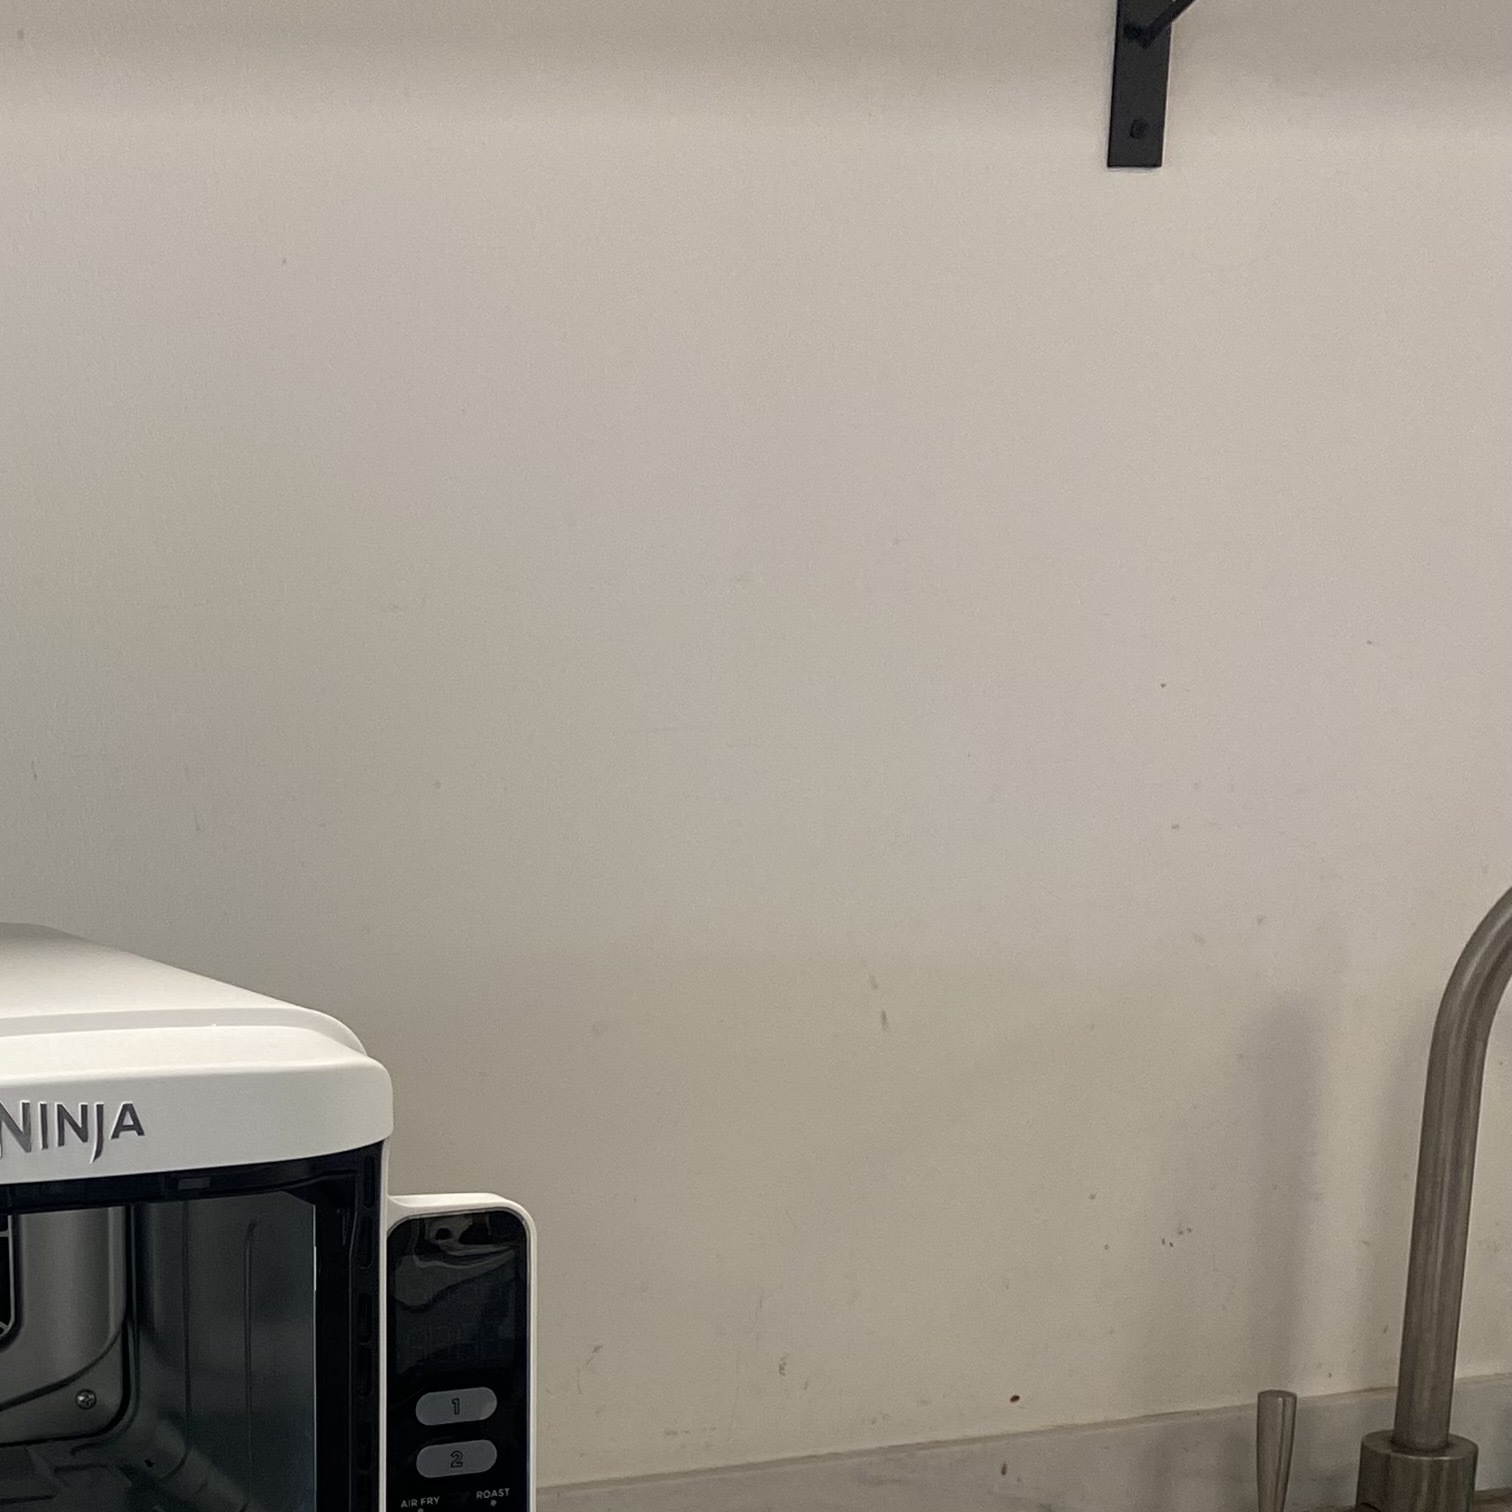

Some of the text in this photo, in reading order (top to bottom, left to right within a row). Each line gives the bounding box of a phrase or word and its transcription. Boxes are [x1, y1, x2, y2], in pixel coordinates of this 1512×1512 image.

[451, 1397, 461, 1415] 1
[450, 1450, 464, 1468] 2
[476, 1488, 510, 1499] ROAST
[400, 1496, 440, 1508] AIR FRY
